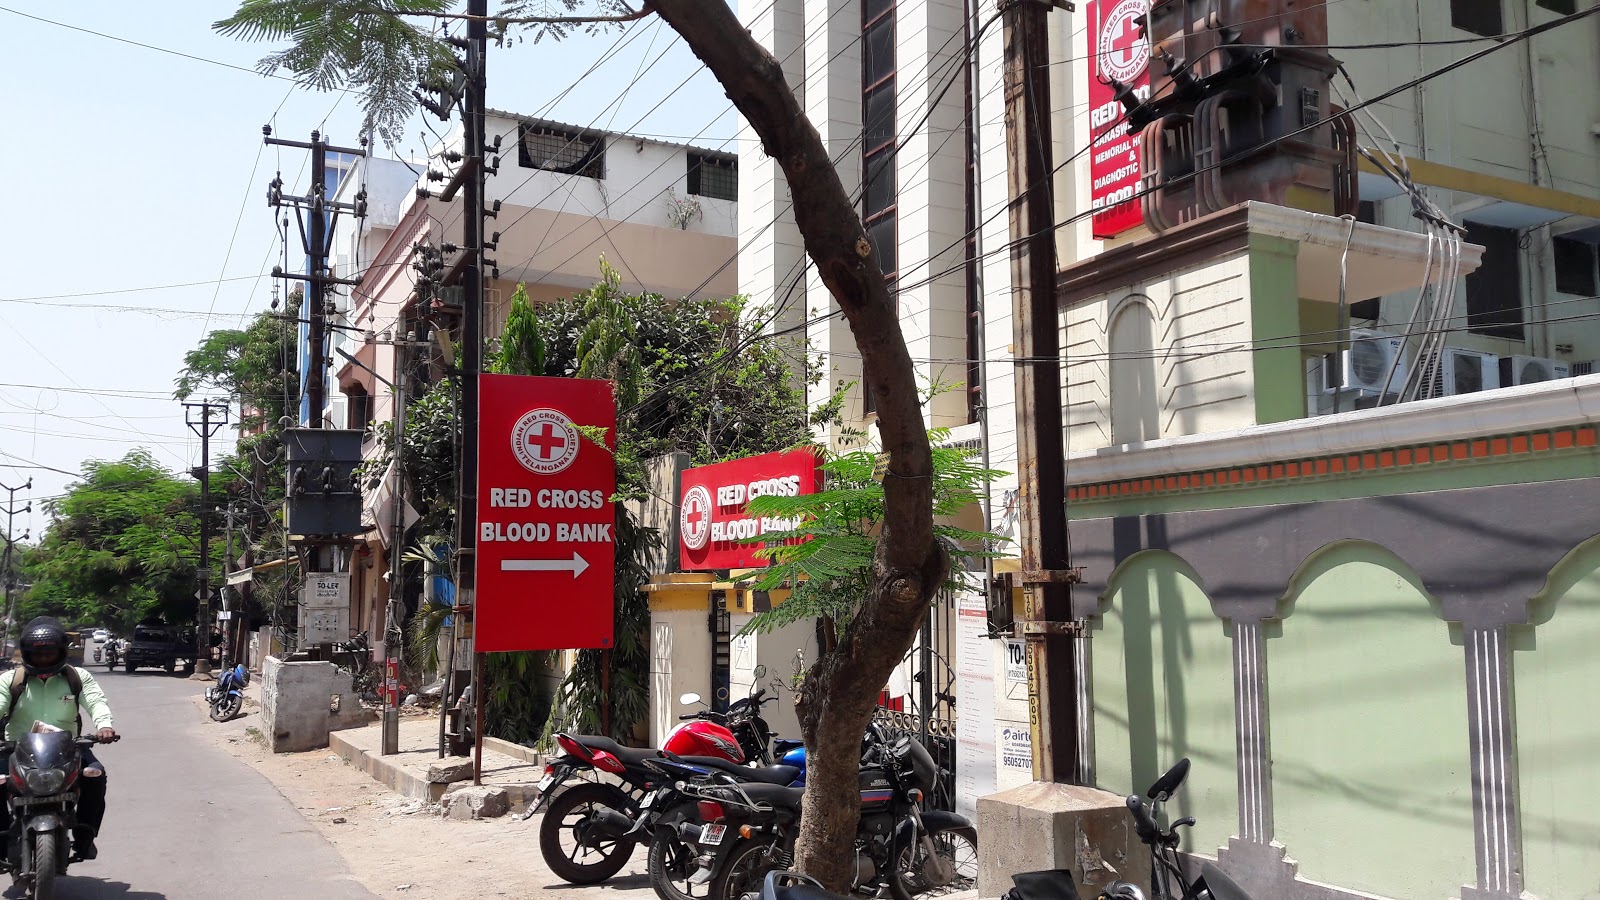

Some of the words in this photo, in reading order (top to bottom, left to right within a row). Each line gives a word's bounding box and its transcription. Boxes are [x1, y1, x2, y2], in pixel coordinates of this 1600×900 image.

[1106, 15, 1118, 33] RED
[1118, 2, 1141, 15] CROSS
[1108, 47, 1149, 79] TELANGANA
[1091, 100, 1118, 129] RED
[1095, 143, 1131, 165] MEMORIAL
[1129, 150, 1136, 162] &
[1094, 161, 1139, 190] DIAGNOSTIC
[1092, 185, 1133, 215] BLOOD
[516, 427, 524, 455] INDIAN
[522, 414, 537, 427] RED
[538, 413, 565, 424] CROSS
[521, 455, 570, 471] TELANGANA
[490, 487, 531, 508] RED
[537, 488, 604, 509] CROSS
[717, 484, 746, 507] RED
[747, 475, 800, 501] CROSS
[480, 522, 551, 542] BLOOD
[556, 523, 612, 542] BANK
[711, 518, 759, 541] BLOOD
